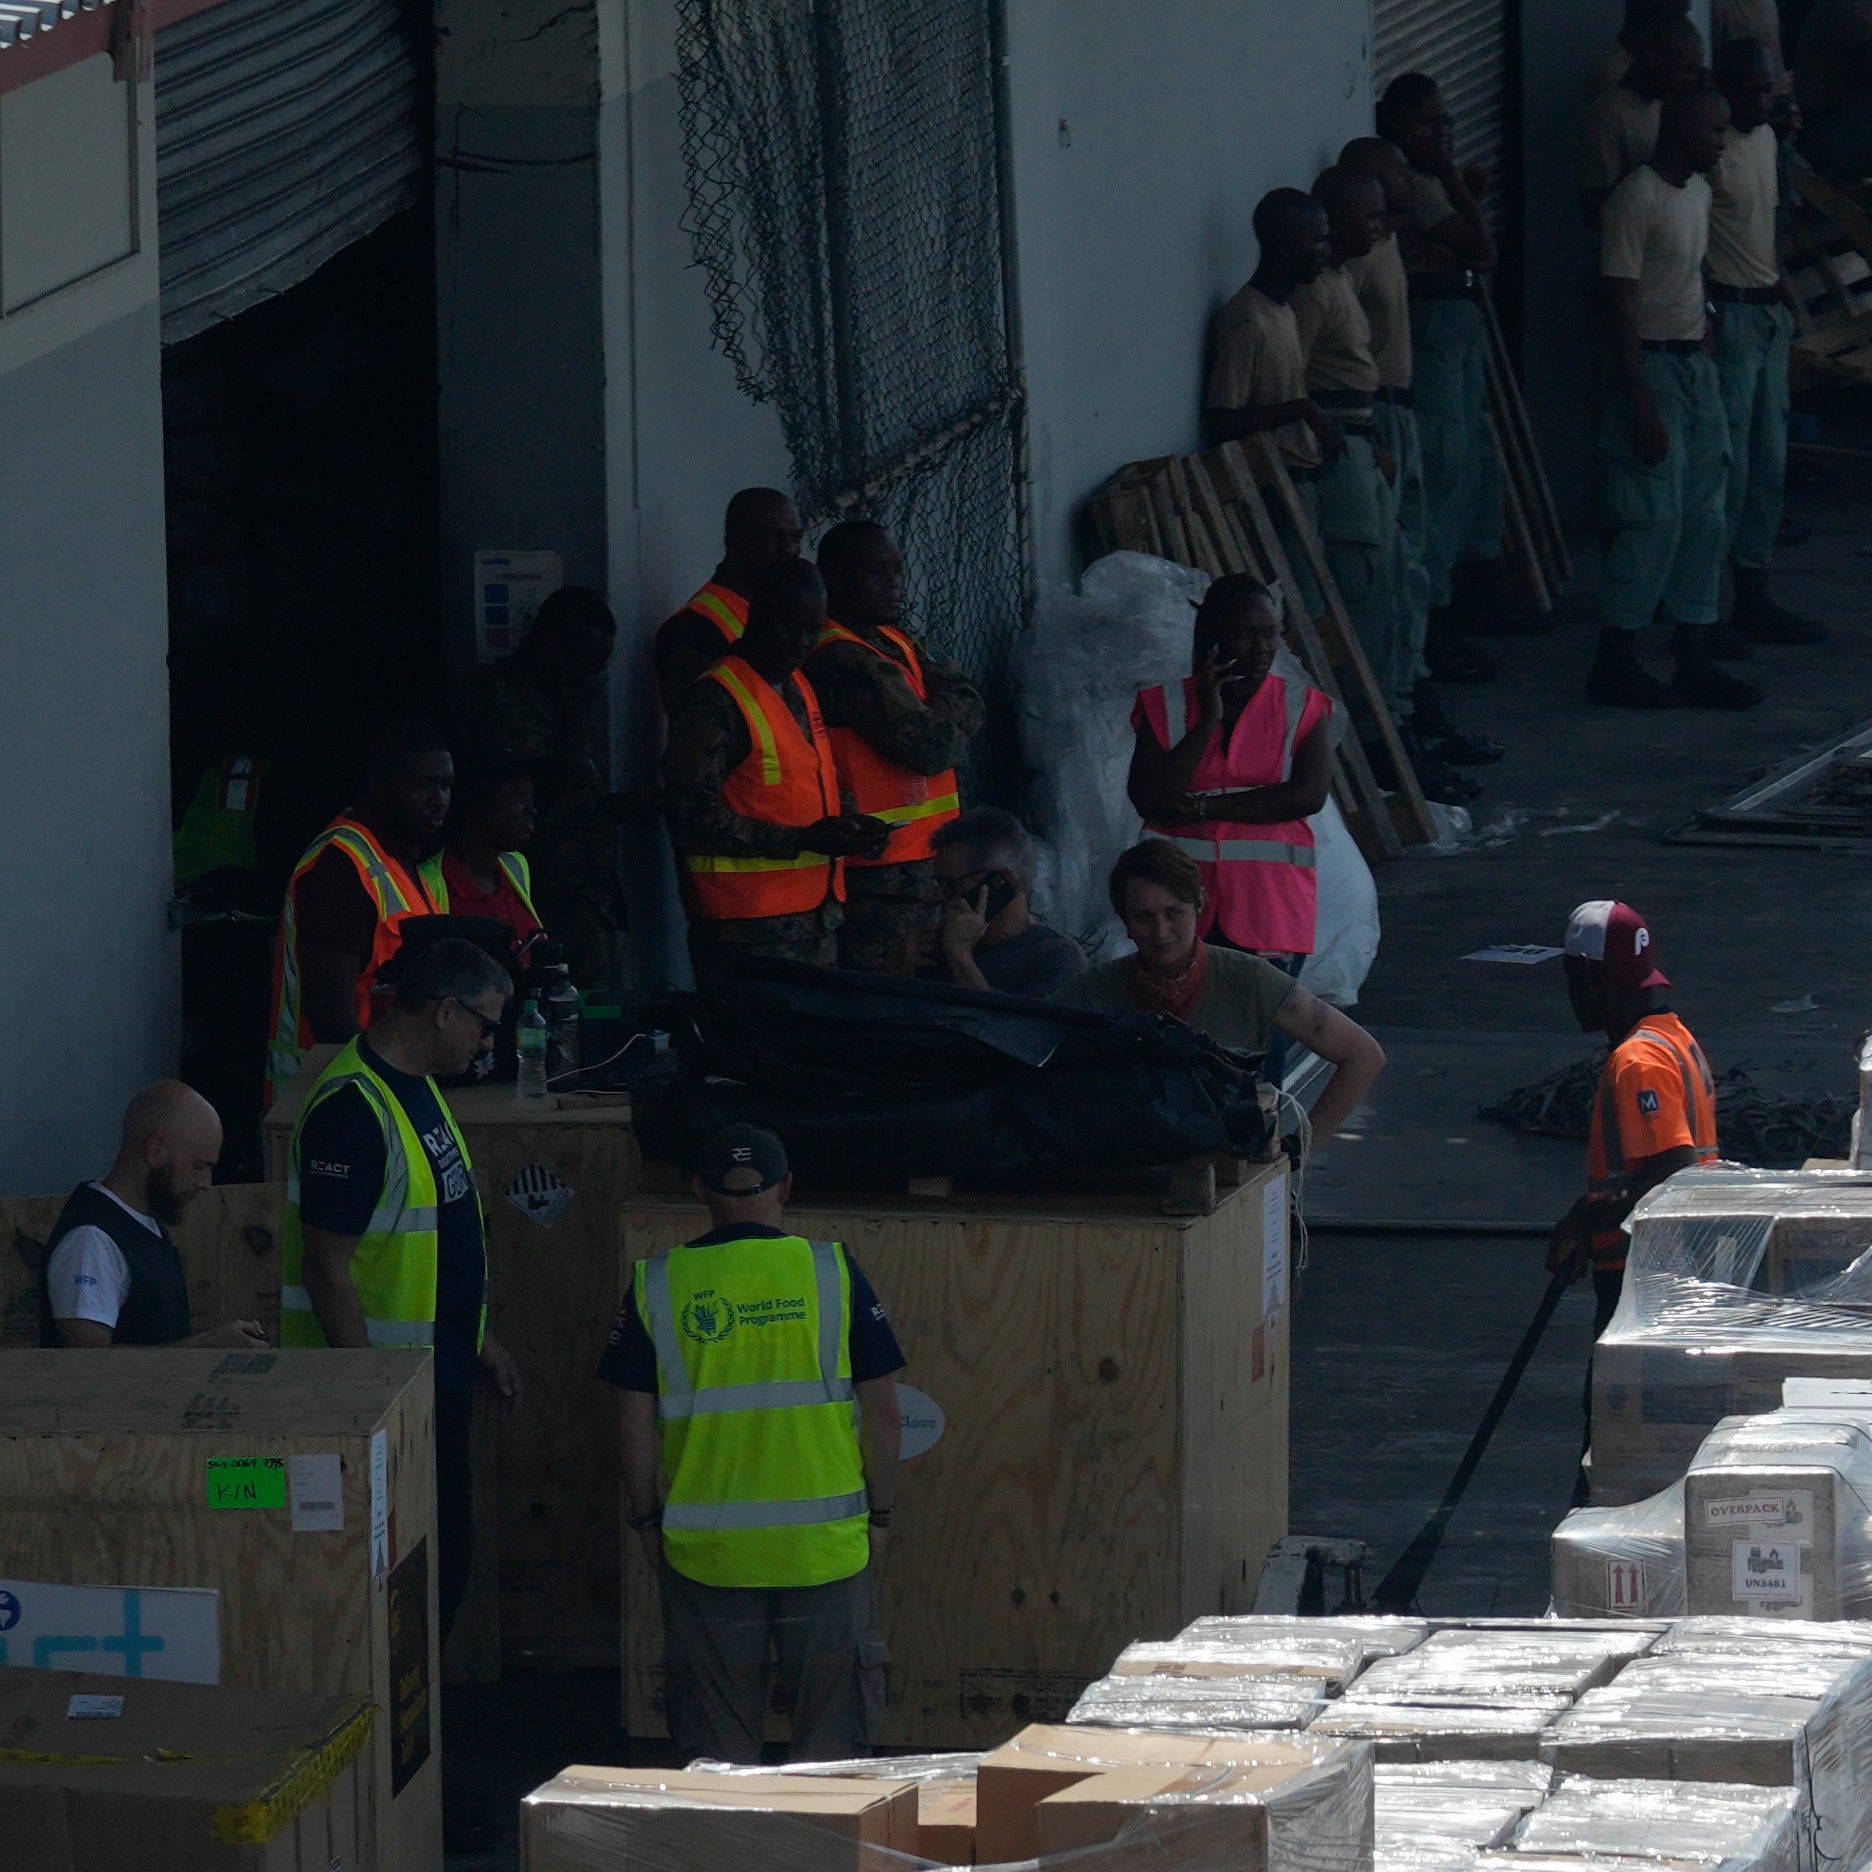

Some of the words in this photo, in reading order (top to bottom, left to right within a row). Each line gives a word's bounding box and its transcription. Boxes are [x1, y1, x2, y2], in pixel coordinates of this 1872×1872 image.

[1634, 927, 1650, 956] P
[1640, 1094, 1657, 1111] M
[309, 1160, 351, 1175] REACT
[692, 1289, 716, 1301] WFP
[736, 1299, 772, 1313] World
[776, 1297, 806, 1309] Food
[739, 1310, 807, 1327] Programme
[1710, 1501, 1782, 1517] OVERPACK
[1744, 1577, 1787, 1589] UN3481
